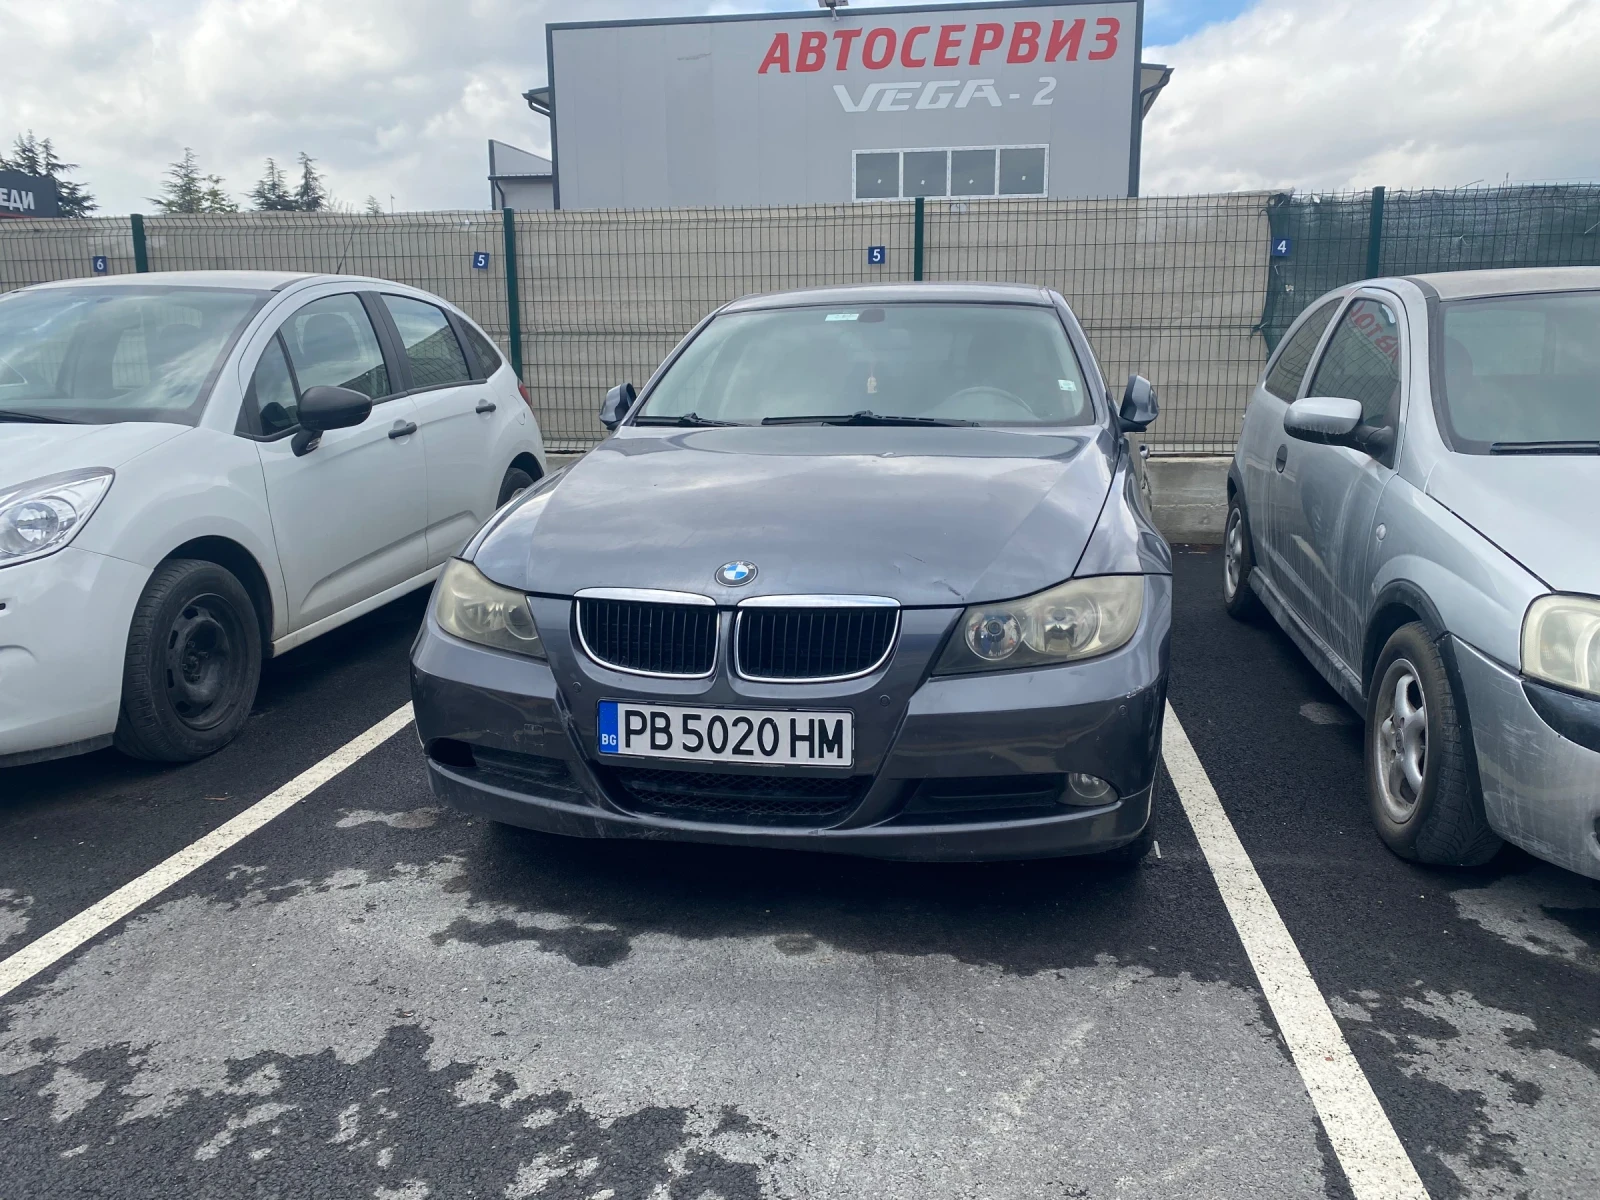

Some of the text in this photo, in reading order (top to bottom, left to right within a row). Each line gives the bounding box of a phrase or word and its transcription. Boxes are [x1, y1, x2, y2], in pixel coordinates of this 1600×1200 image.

[758, 17, 1121, 74] АВТОСЕРВИЗ
[1277, 240, 1287, 254] 4
[477, 254, 486, 267] 5
[872, 248, 881, 262] 5
[96, 258, 104, 270] 6
[601, 733, 617, 746] BG
